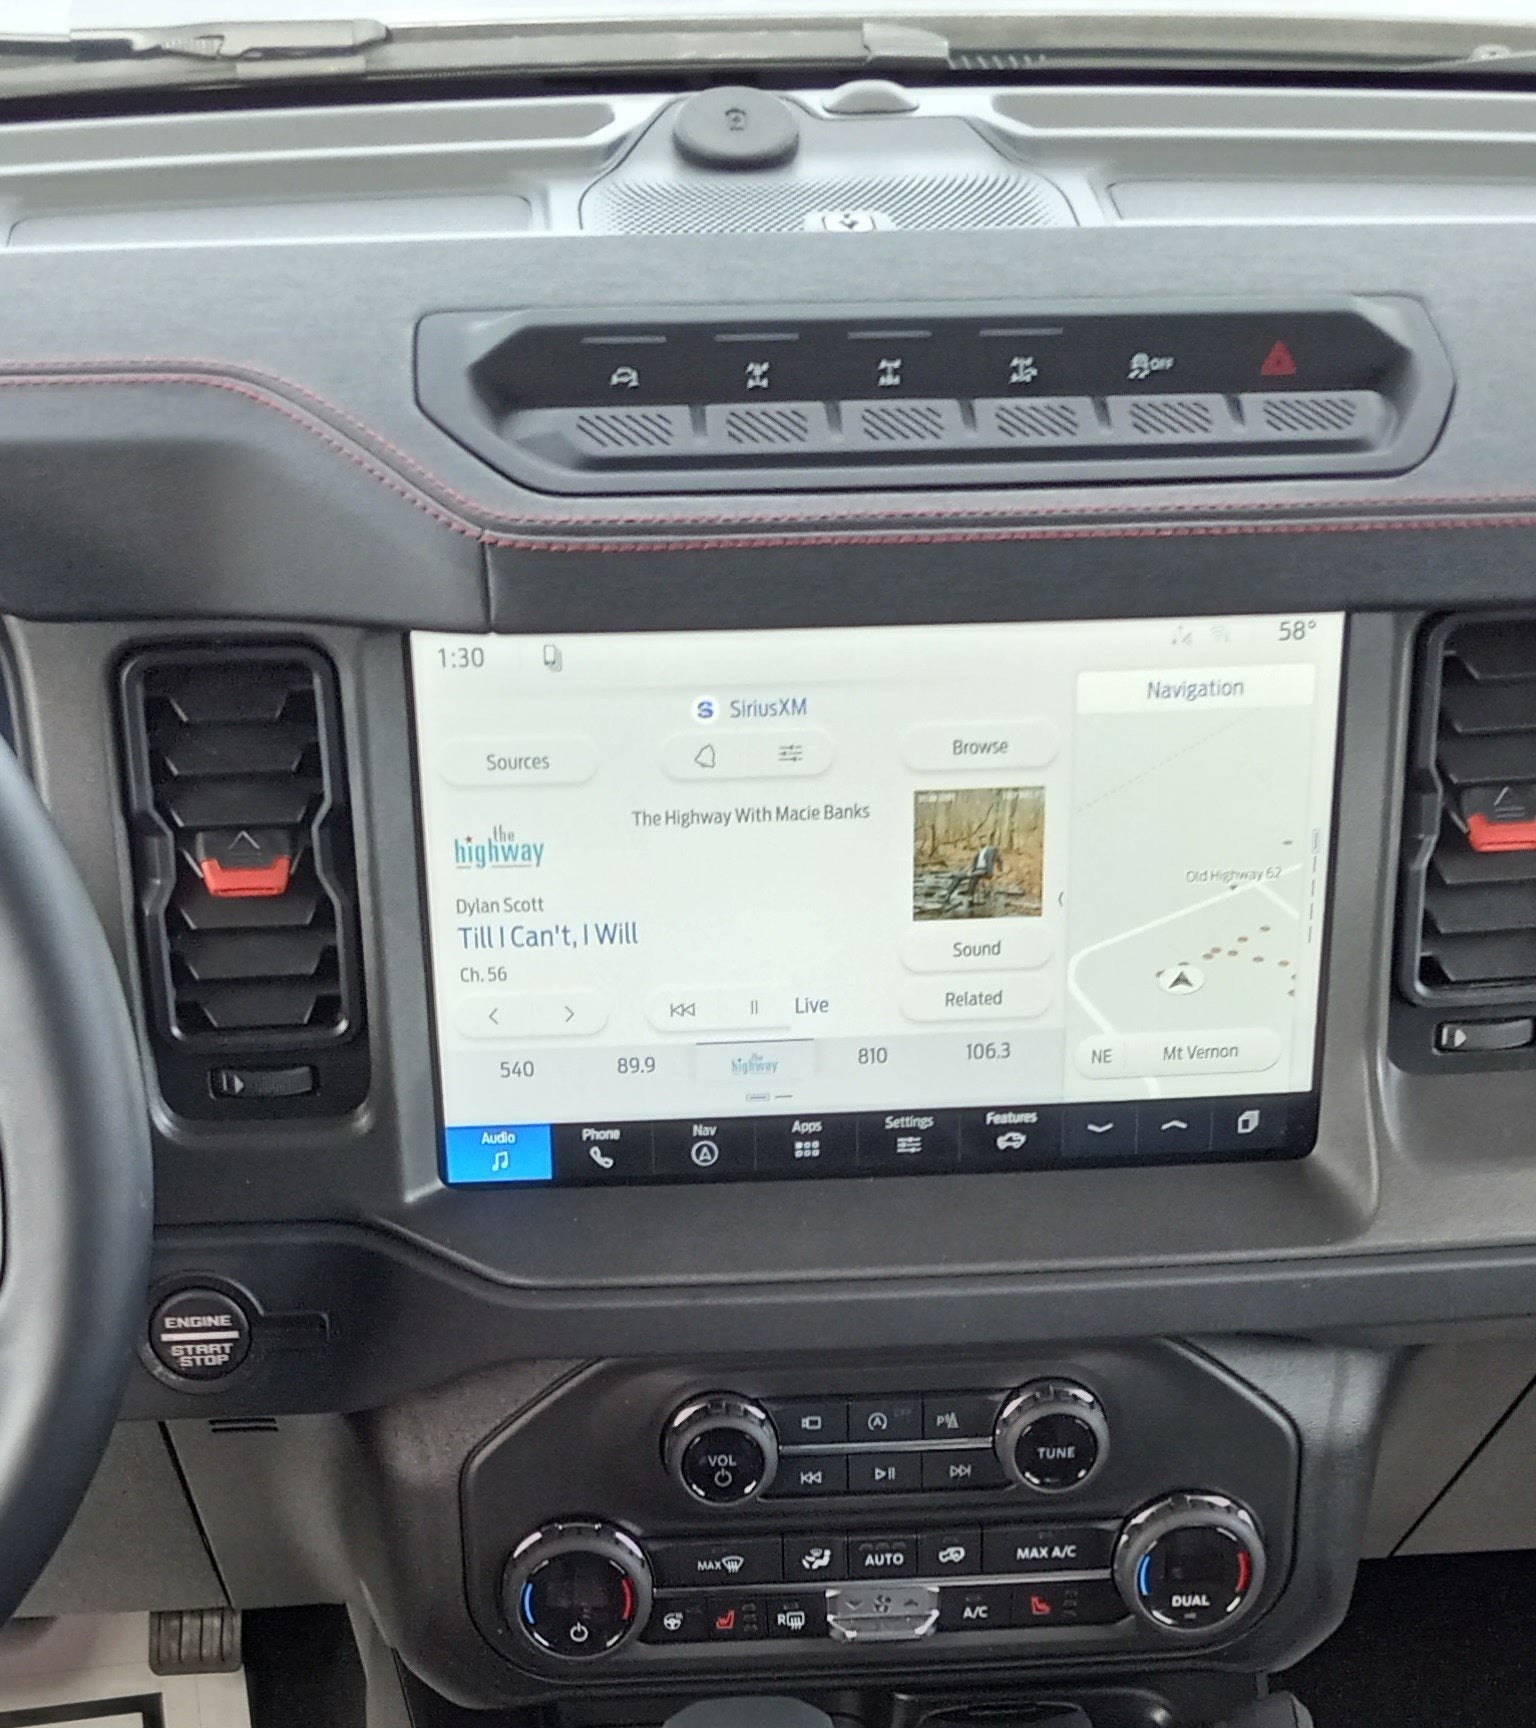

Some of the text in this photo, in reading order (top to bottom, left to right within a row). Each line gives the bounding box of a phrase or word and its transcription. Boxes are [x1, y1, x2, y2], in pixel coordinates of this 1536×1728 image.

[1278, 620, 1317, 642] 58°
[438, 647, 485, 670] 1:30
[1147, 679, 1244, 702] Navigation
[730, 697, 808, 719] SiriusXM
[952, 739, 1009, 756] Browse
[486, 753, 550, 771] Sources
[632, 803, 870, 829] The Highway With Macie Banks
[493, 825, 515, 842] the
[455, 836, 544, 868] highway
[1210, 867, 1263, 884] Highway
[456, 896, 544, 917] Dylan Scott
[458, 926, 494, 949] Till
[511, 924, 577, 952] Can't,
[594, 922, 639, 946] Will
[953, 941, 1001, 958] Sound
[460, 966, 508, 983] Ch. 56
[795, 997, 829, 1015] Live
[945, 990, 1003, 1008] Related
[858, 1043, 1011, 1065] 810 106.3
[1091, 1044, 1239, 1065] NE Mt Vernon
[500, 1056, 656, 1079] 540 89.9
[792, 1119, 822, 1135] Apps
[884, 1115, 934, 1131] Settings
[986, 1111, 1038, 1126] Features
[481, 1130, 516, 1146] Audio
[582, 1128, 621, 1143] Phone
[692, 1124, 717, 1138] Nav
[164, 1315, 232, 1328] ENGINE
[171, 1343, 234, 1356] START
[180, 1354, 230, 1367] STOP
[707, 1454, 737, 1468] VOL
[1037, 1446, 1076, 1460] TUNE
[865, 1553, 904, 1567] AUTO
[1016, 1544, 1077, 1560] MAX A/C
[697, 1560, 722, 1572] MAX
[1171, 1594, 1210, 1608] DUAL
[777, 1613, 786, 1627] R
[963, 1605, 988, 1620] A/C
